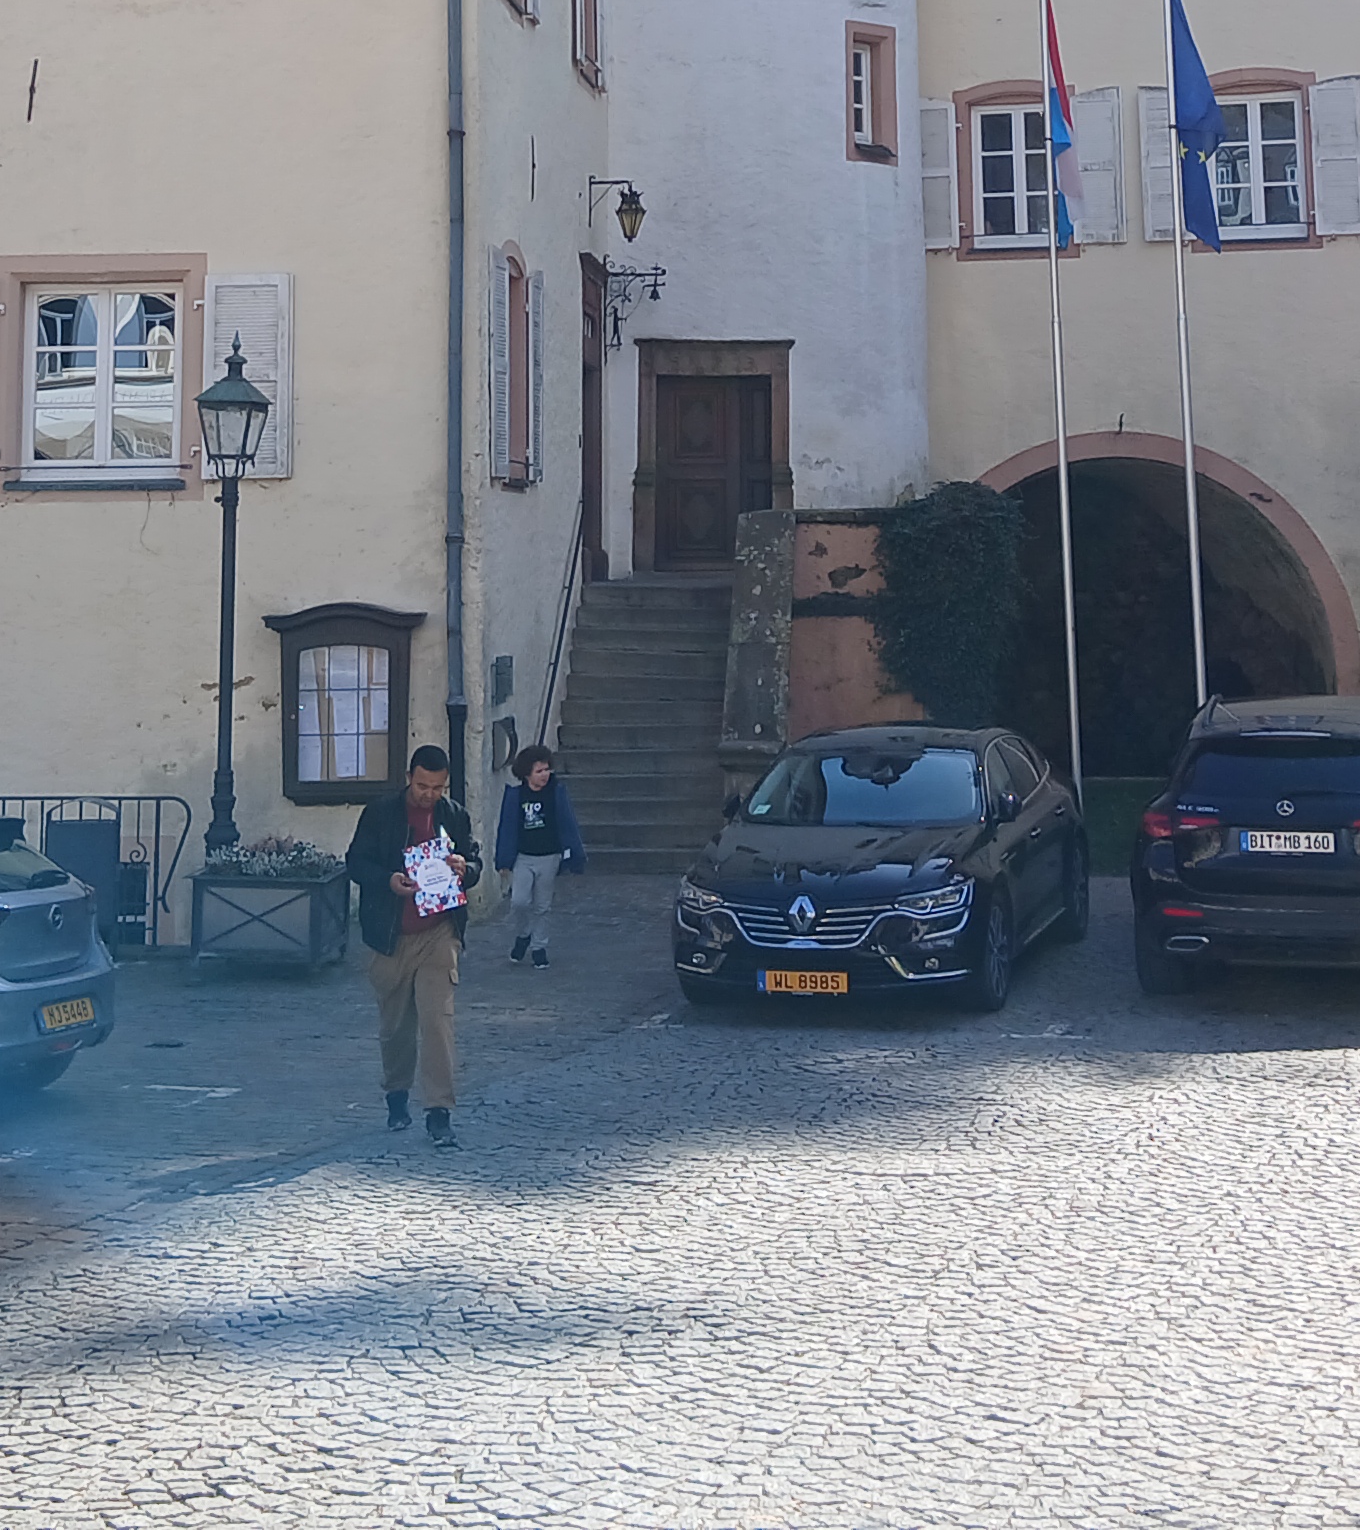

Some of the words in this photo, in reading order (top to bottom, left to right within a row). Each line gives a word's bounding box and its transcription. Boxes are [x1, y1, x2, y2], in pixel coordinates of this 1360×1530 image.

[1250, 834, 1274, 849] BIT
[1283, 835, 1301, 850] MB
[1304, 835, 1330, 850] 160
[774, 973, 794, 989] WL
[798, 974, 840, 990] 8985
